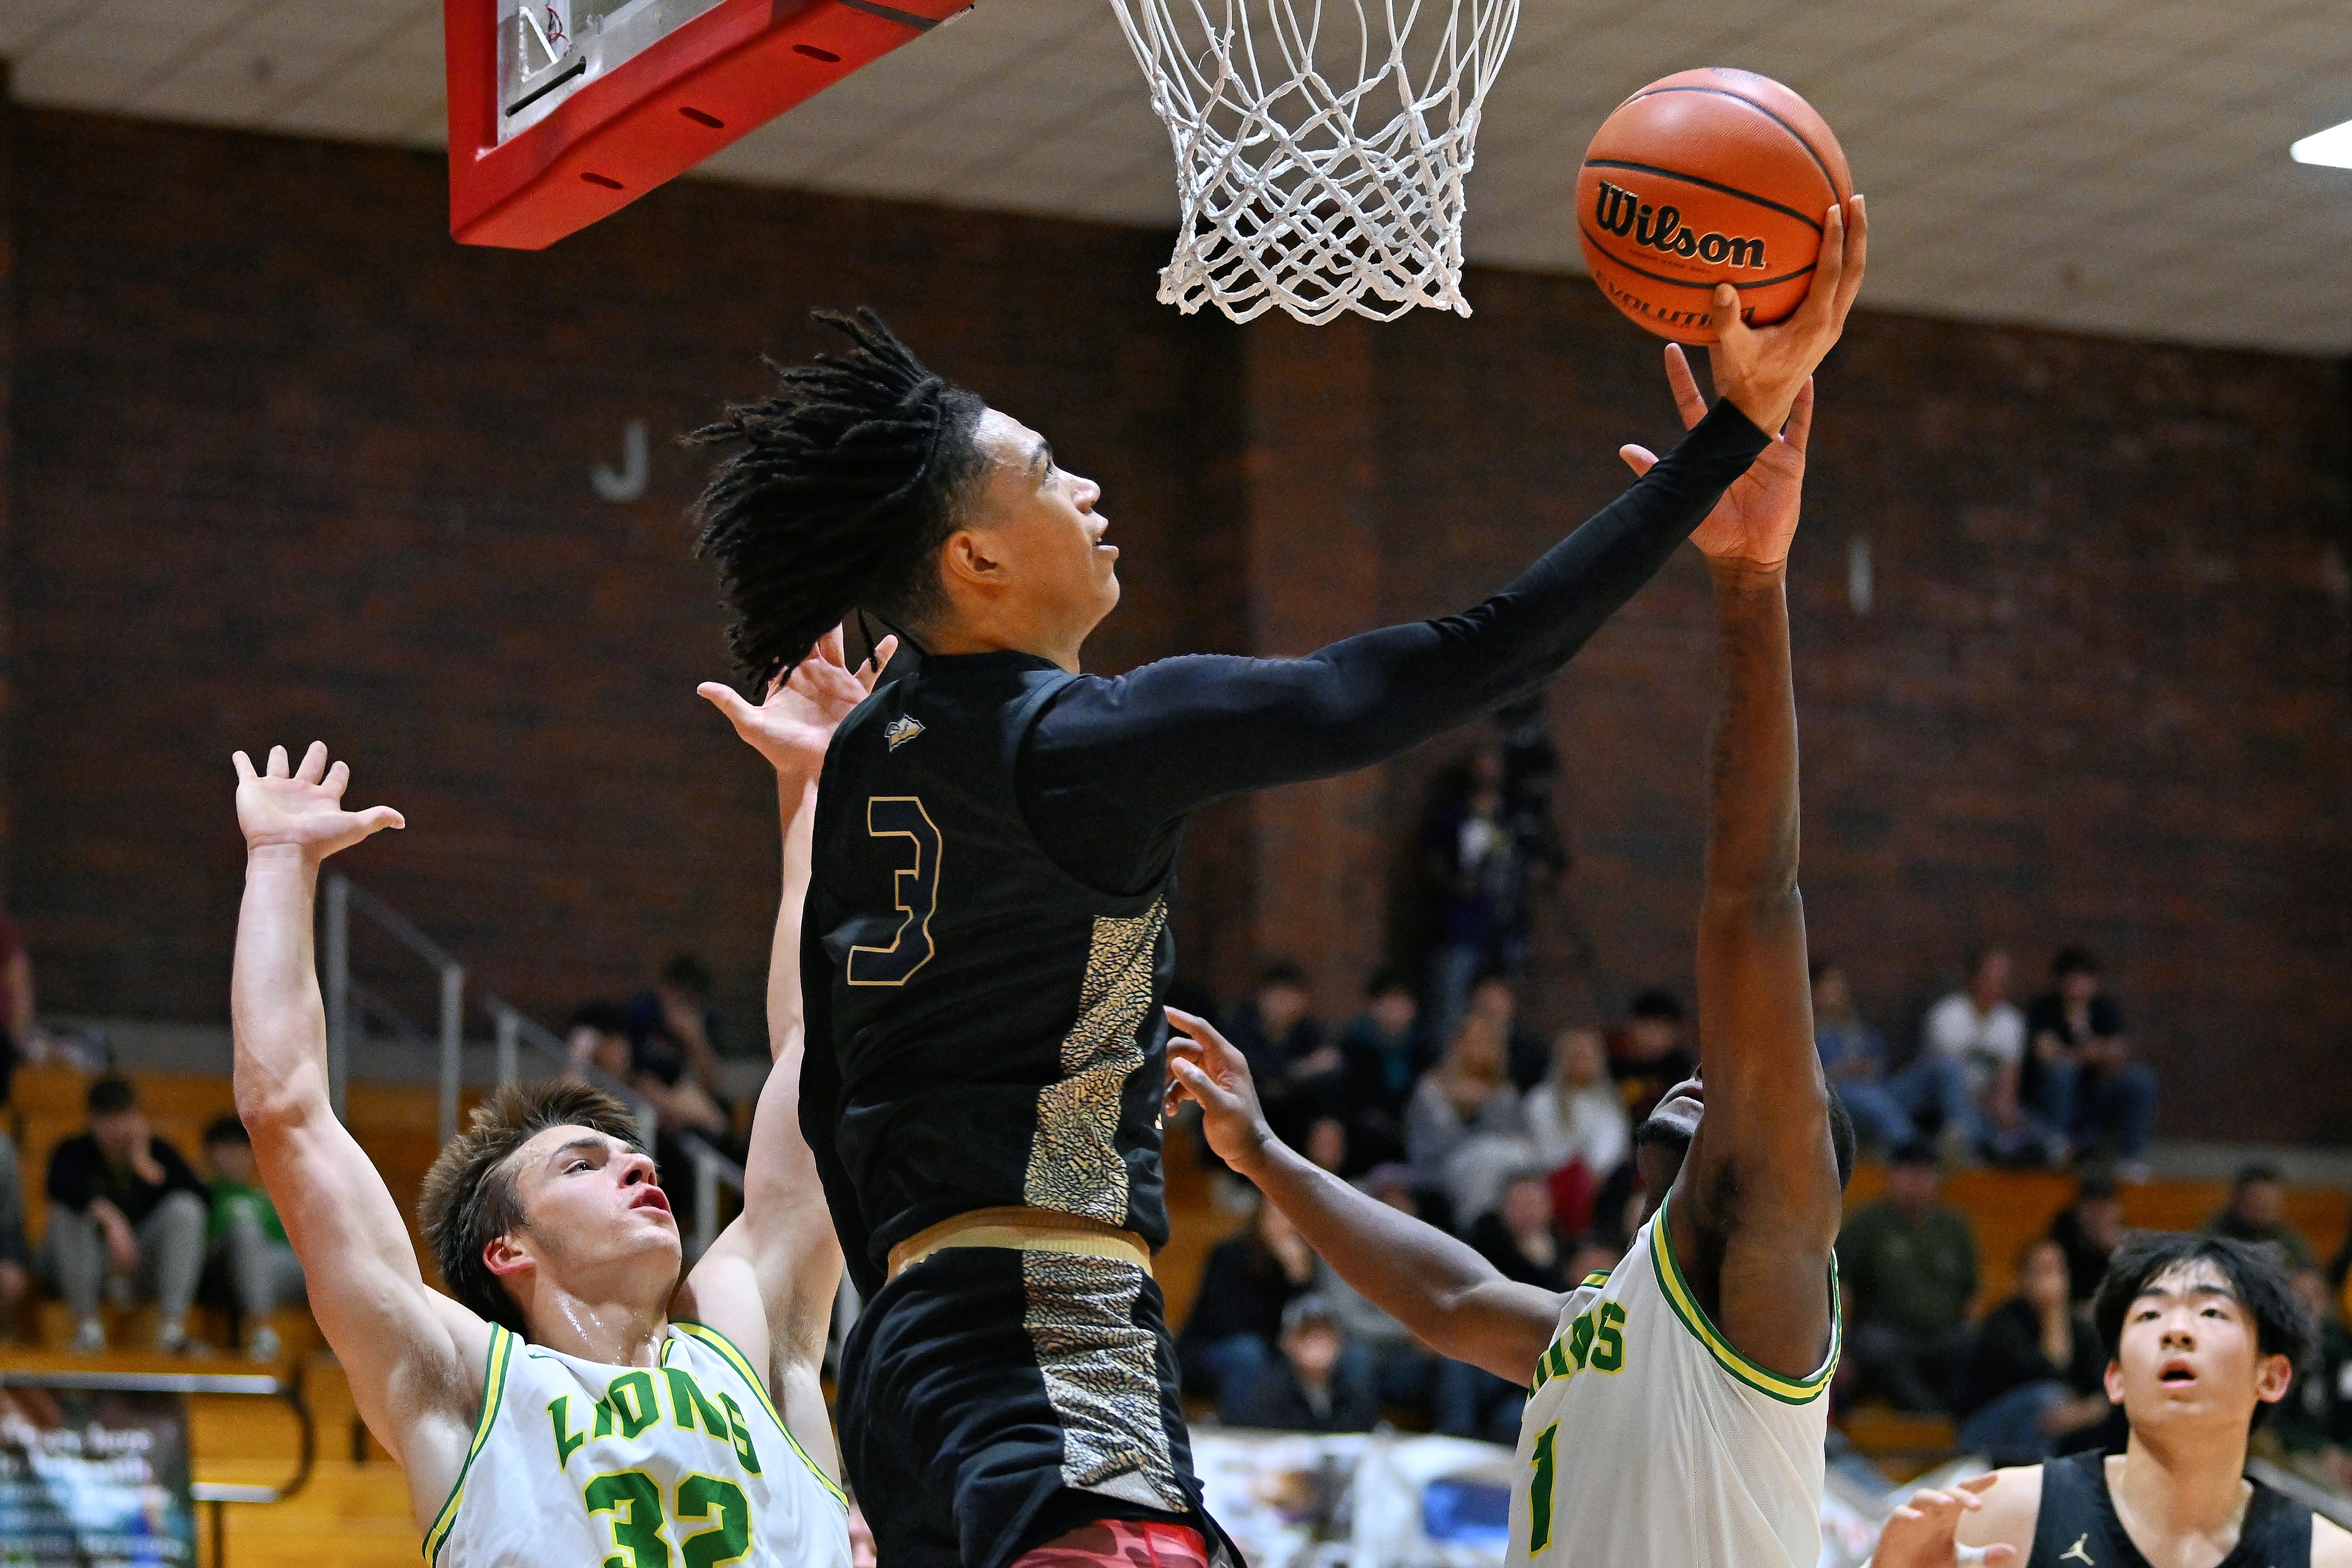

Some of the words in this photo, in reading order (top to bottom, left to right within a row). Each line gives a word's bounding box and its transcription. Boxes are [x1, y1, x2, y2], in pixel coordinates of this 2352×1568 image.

[1595, 180, 1766, 270] Wilson
[1595, 269, 1755, 327] VOLUTI
[589, 419, 647, 503] J
[847, 795, 943, 986] 3
[547, 1366, 764, 1478] LIONS
[581, 1467, 754, 1568] 32
[1529, 1417, 1561, 1559] 1
